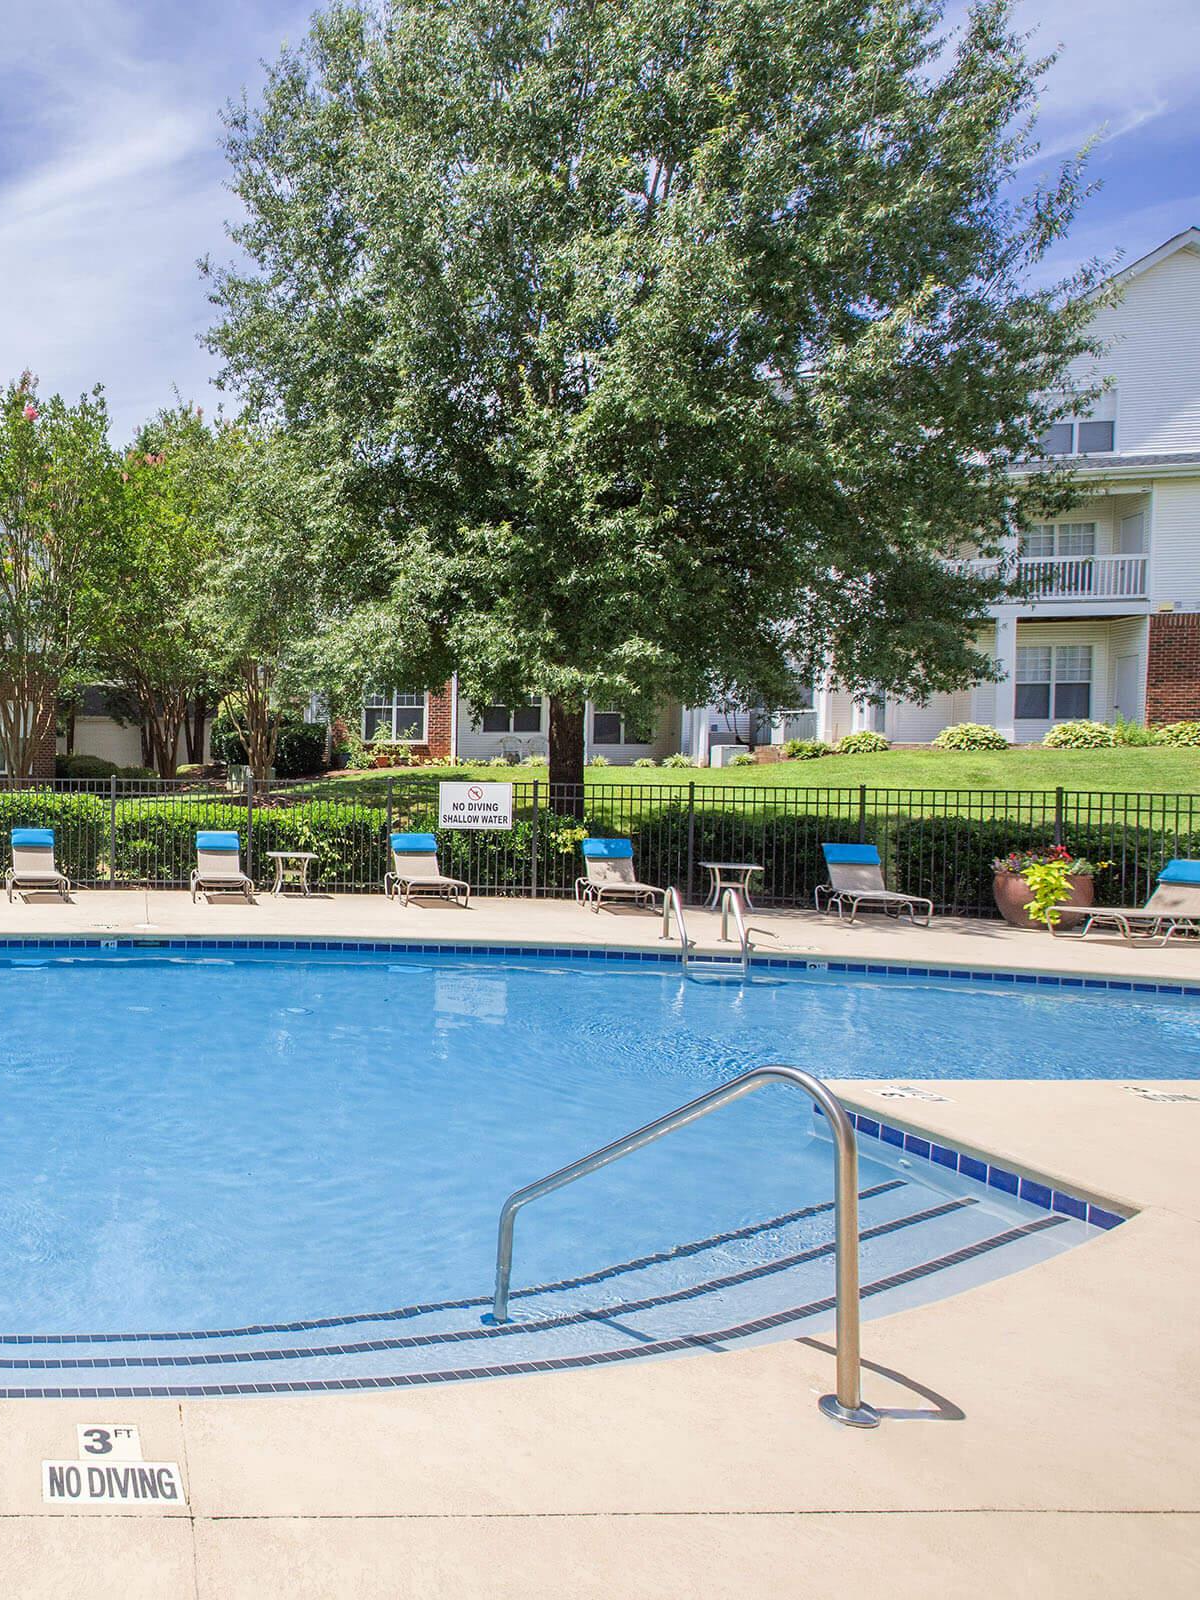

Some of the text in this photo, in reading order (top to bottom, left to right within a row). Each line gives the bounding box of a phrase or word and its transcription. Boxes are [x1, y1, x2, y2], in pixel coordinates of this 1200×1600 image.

[452, 802, 499, 812] NO DIVING
[442, 814, 508, 825] SHALLOW WATER
[83, 1428, 133, 1454] 3 FT
[48, 1466, 178, 1500] NO DIVING
